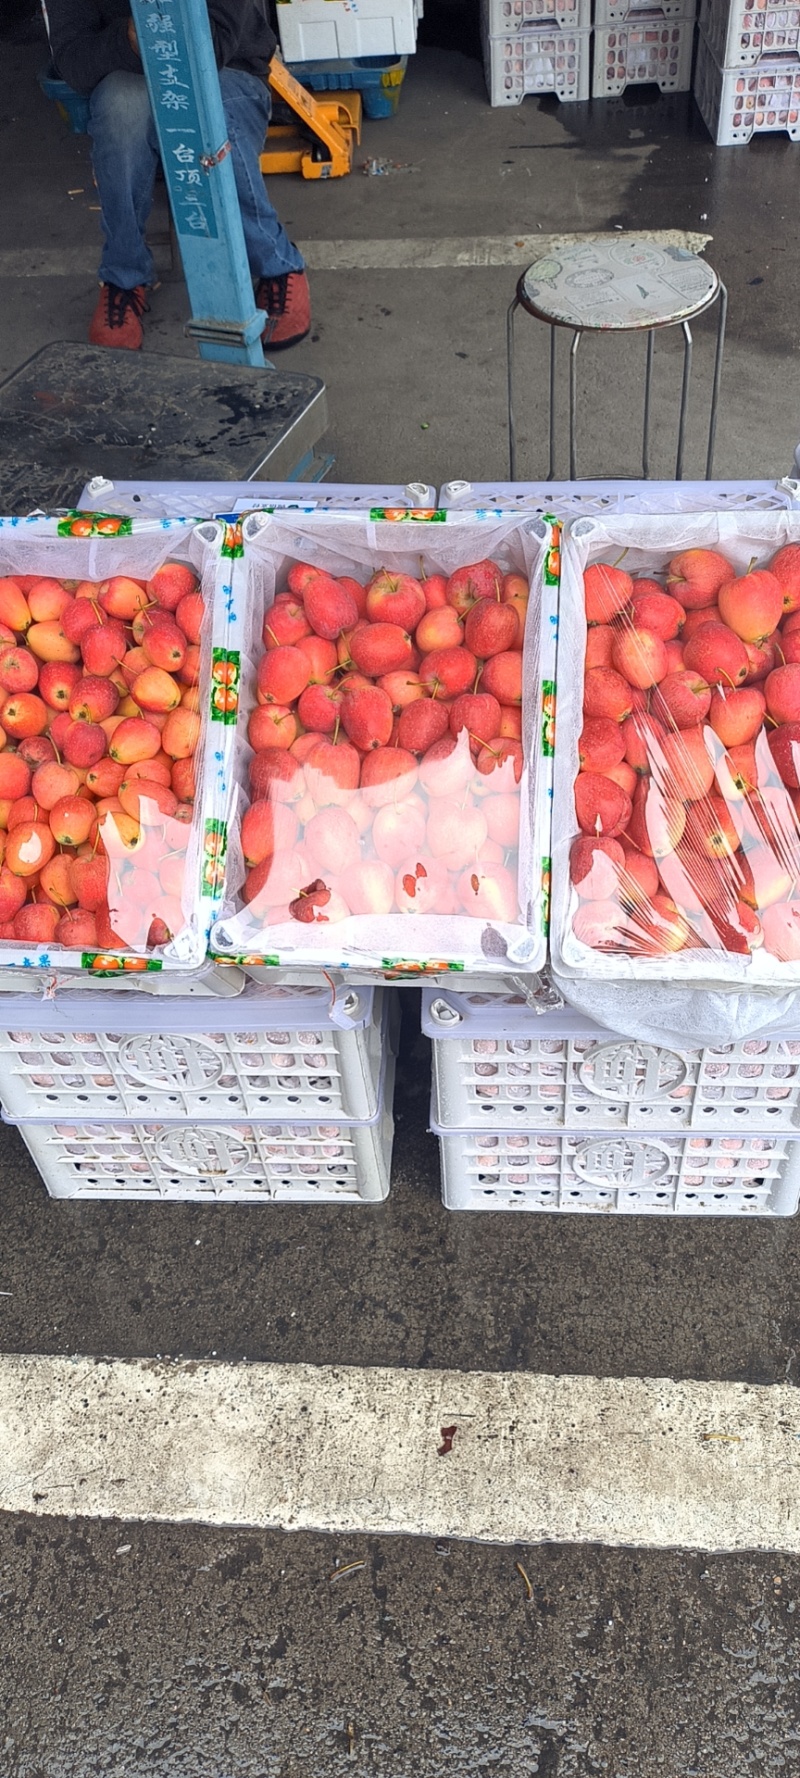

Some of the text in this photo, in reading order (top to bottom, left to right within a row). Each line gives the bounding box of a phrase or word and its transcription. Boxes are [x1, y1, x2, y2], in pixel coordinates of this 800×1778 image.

[139, 0, 207, 230] 强型支架一台顶三台
